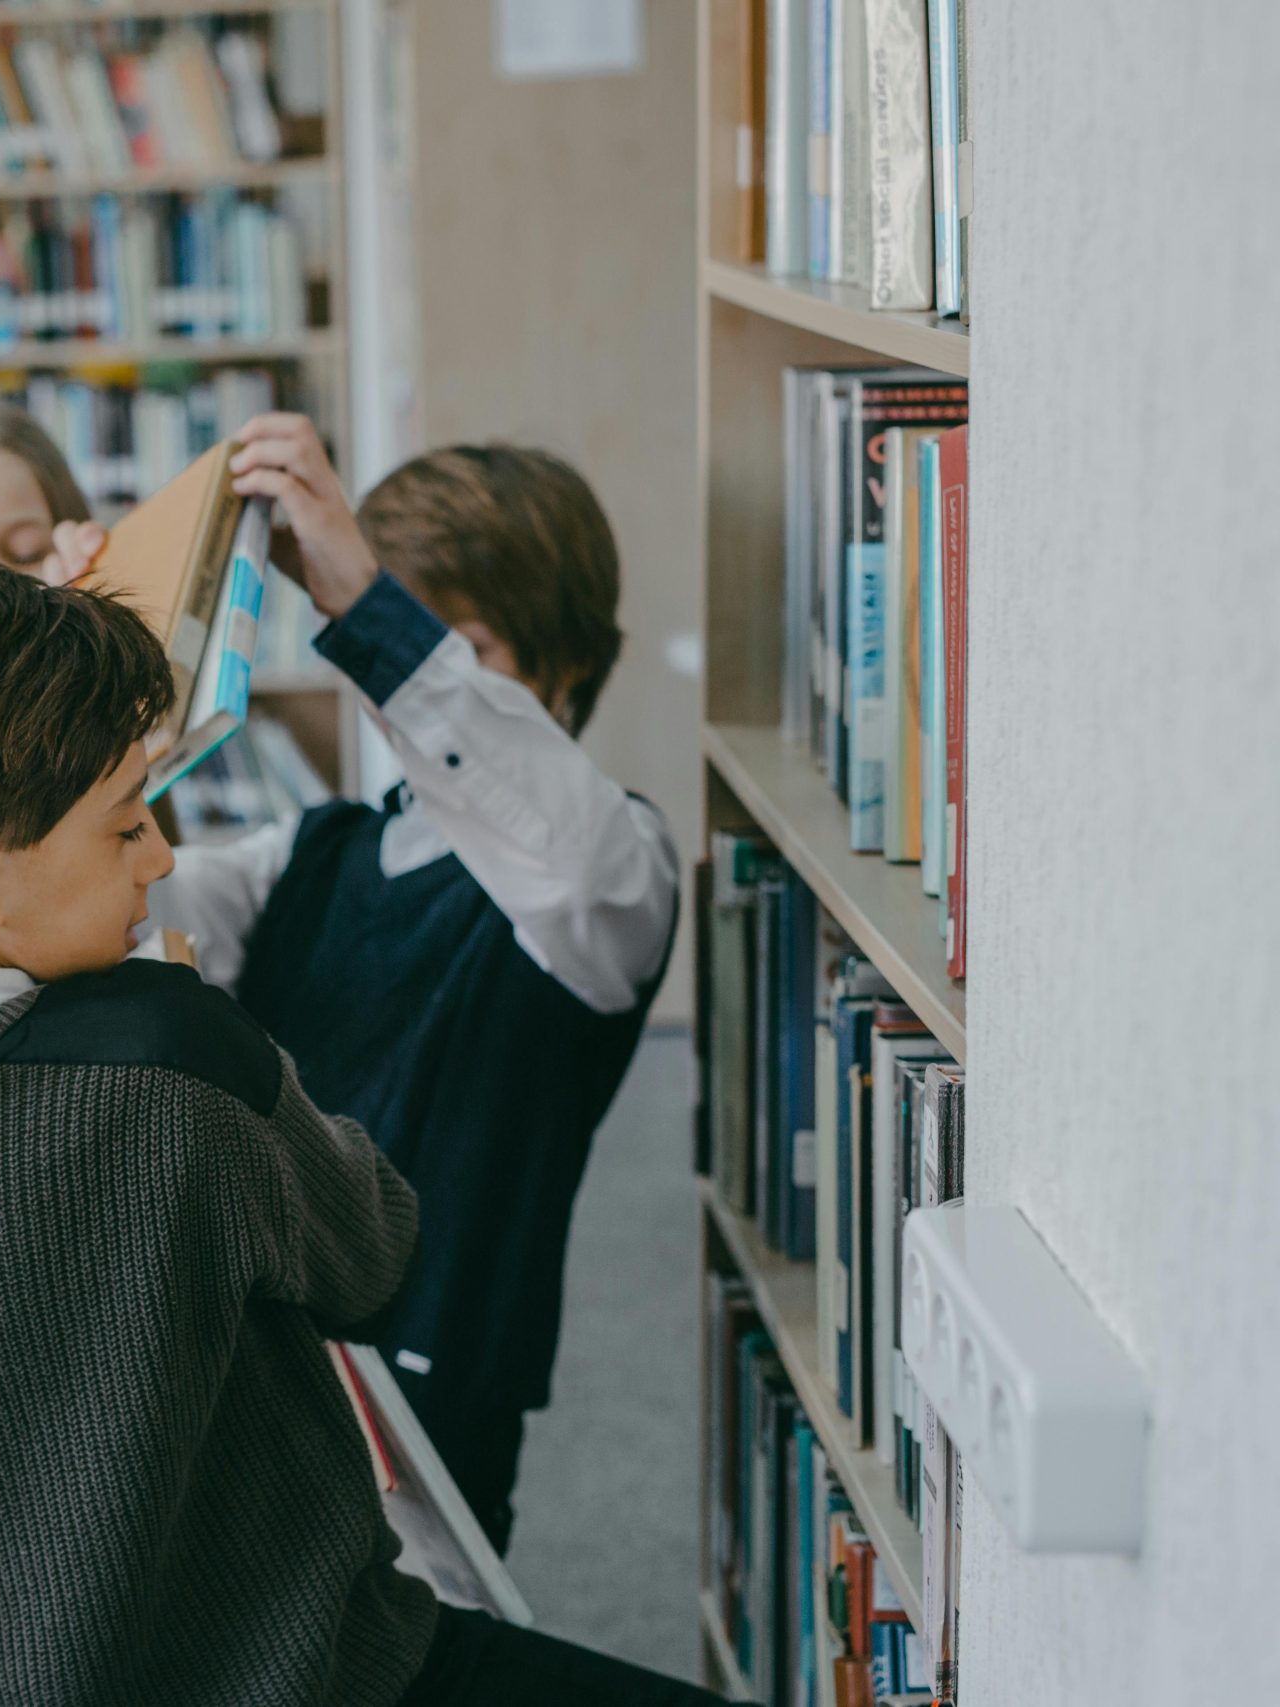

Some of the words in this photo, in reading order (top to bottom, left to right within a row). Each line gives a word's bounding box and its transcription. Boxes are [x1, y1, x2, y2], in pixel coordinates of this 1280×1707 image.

[873, 48, 890, 150] services
[875, 157, 892, 228] social
[950, 532, 958, 553] OF
